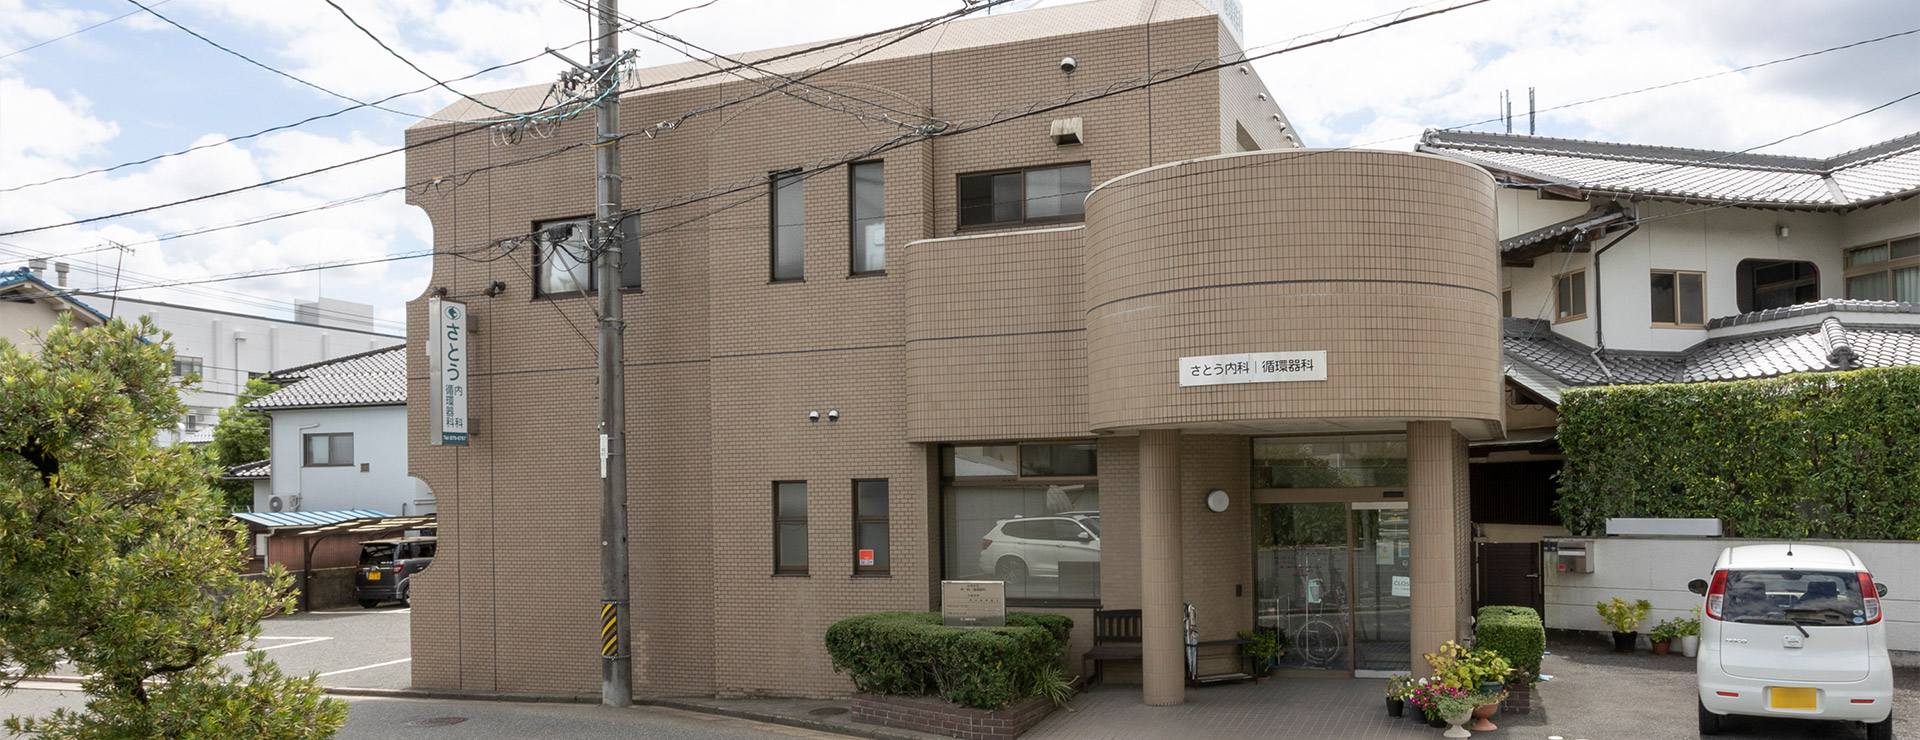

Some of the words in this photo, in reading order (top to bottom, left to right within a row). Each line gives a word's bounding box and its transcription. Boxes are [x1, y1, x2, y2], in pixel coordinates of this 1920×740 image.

[446, 322, 460, 381] さとう
[1190, 361, 1250, 377] さとう内科
[1262, 358, 1314, 374] 循環器科
[445, 384, 455, 428] 循環器科
